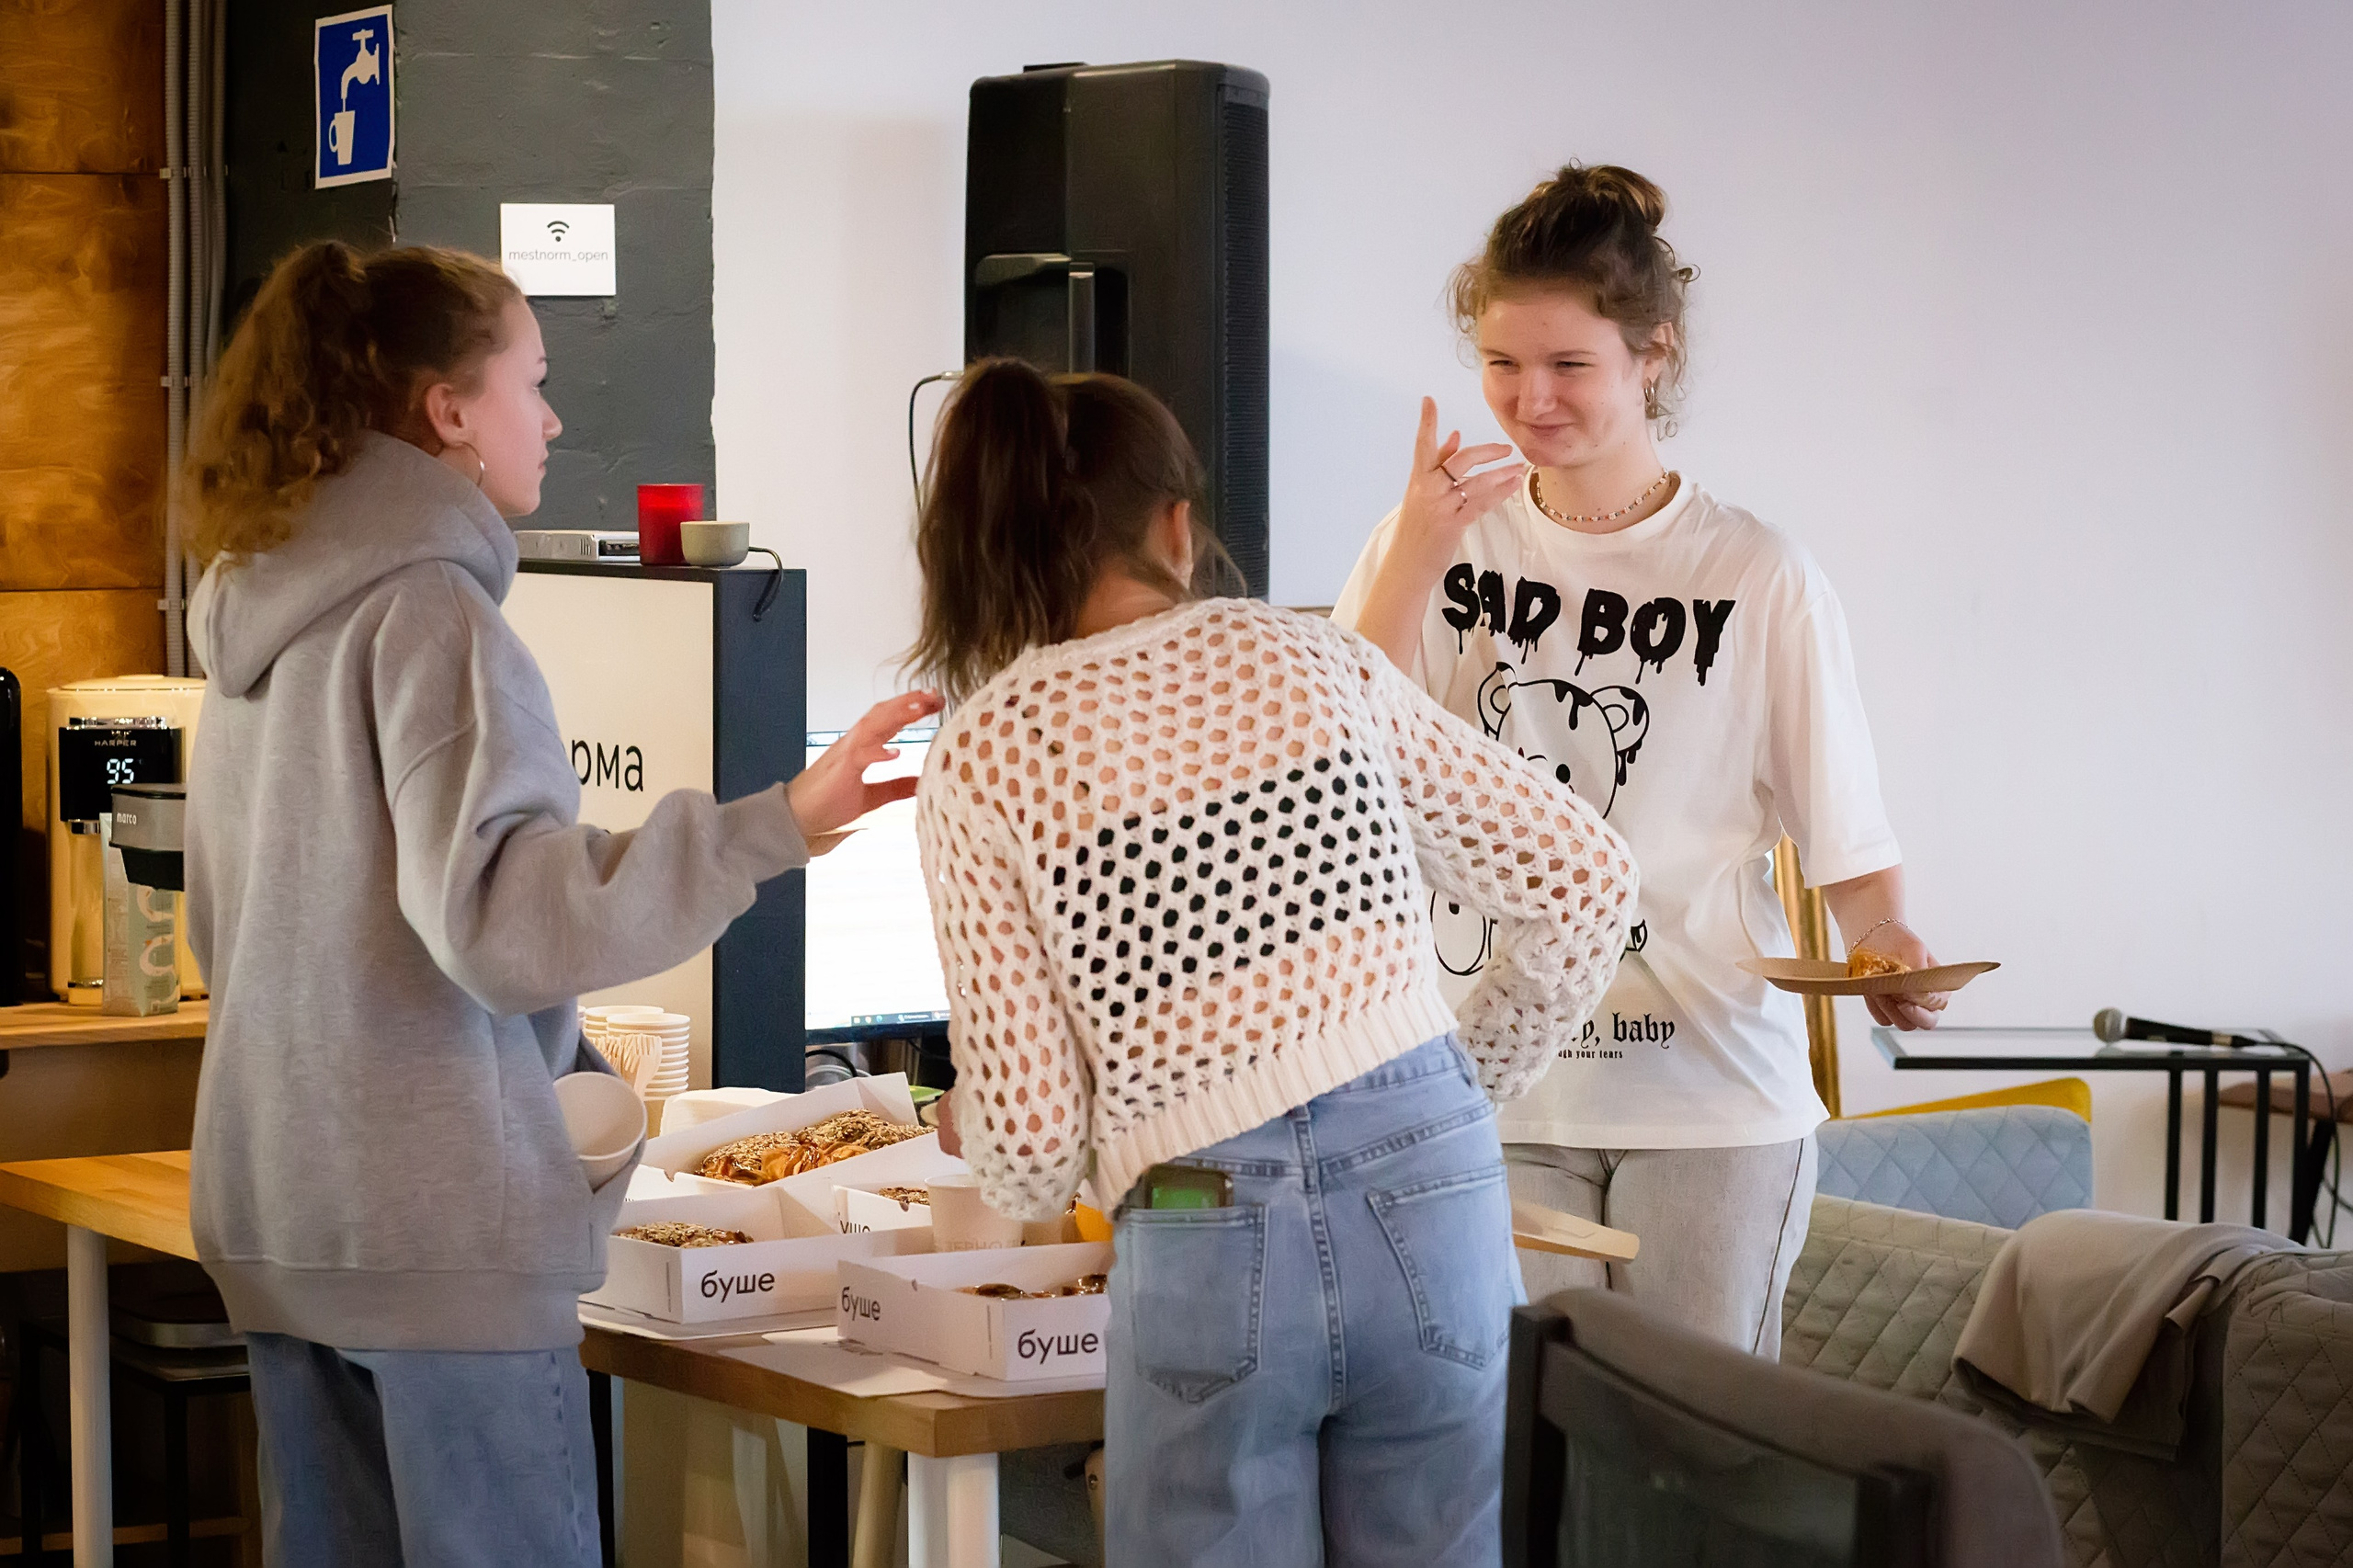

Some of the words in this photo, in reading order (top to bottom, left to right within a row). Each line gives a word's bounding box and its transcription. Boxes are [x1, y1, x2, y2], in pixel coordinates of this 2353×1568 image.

[508, 249, 608, 263] mestnorm_open
[1441, 562, 1562, 664] SAD
[1574, 587, 1736, 687] BOY
[94, 739, 137, 747] HARPER
[106, 757, 135, 785] 95
[116, 812, 137, 825] marco
[1611, 1012, 1676, 1050] baby
[1575, 1051, 1596, 1060] your
[1599, 1050, 1623, 1059] tears
[700, 1269, 775, 1303] буше
[841, 1286, 881, 1321] буше
[1017, 1328, 1098, 1365] буше
